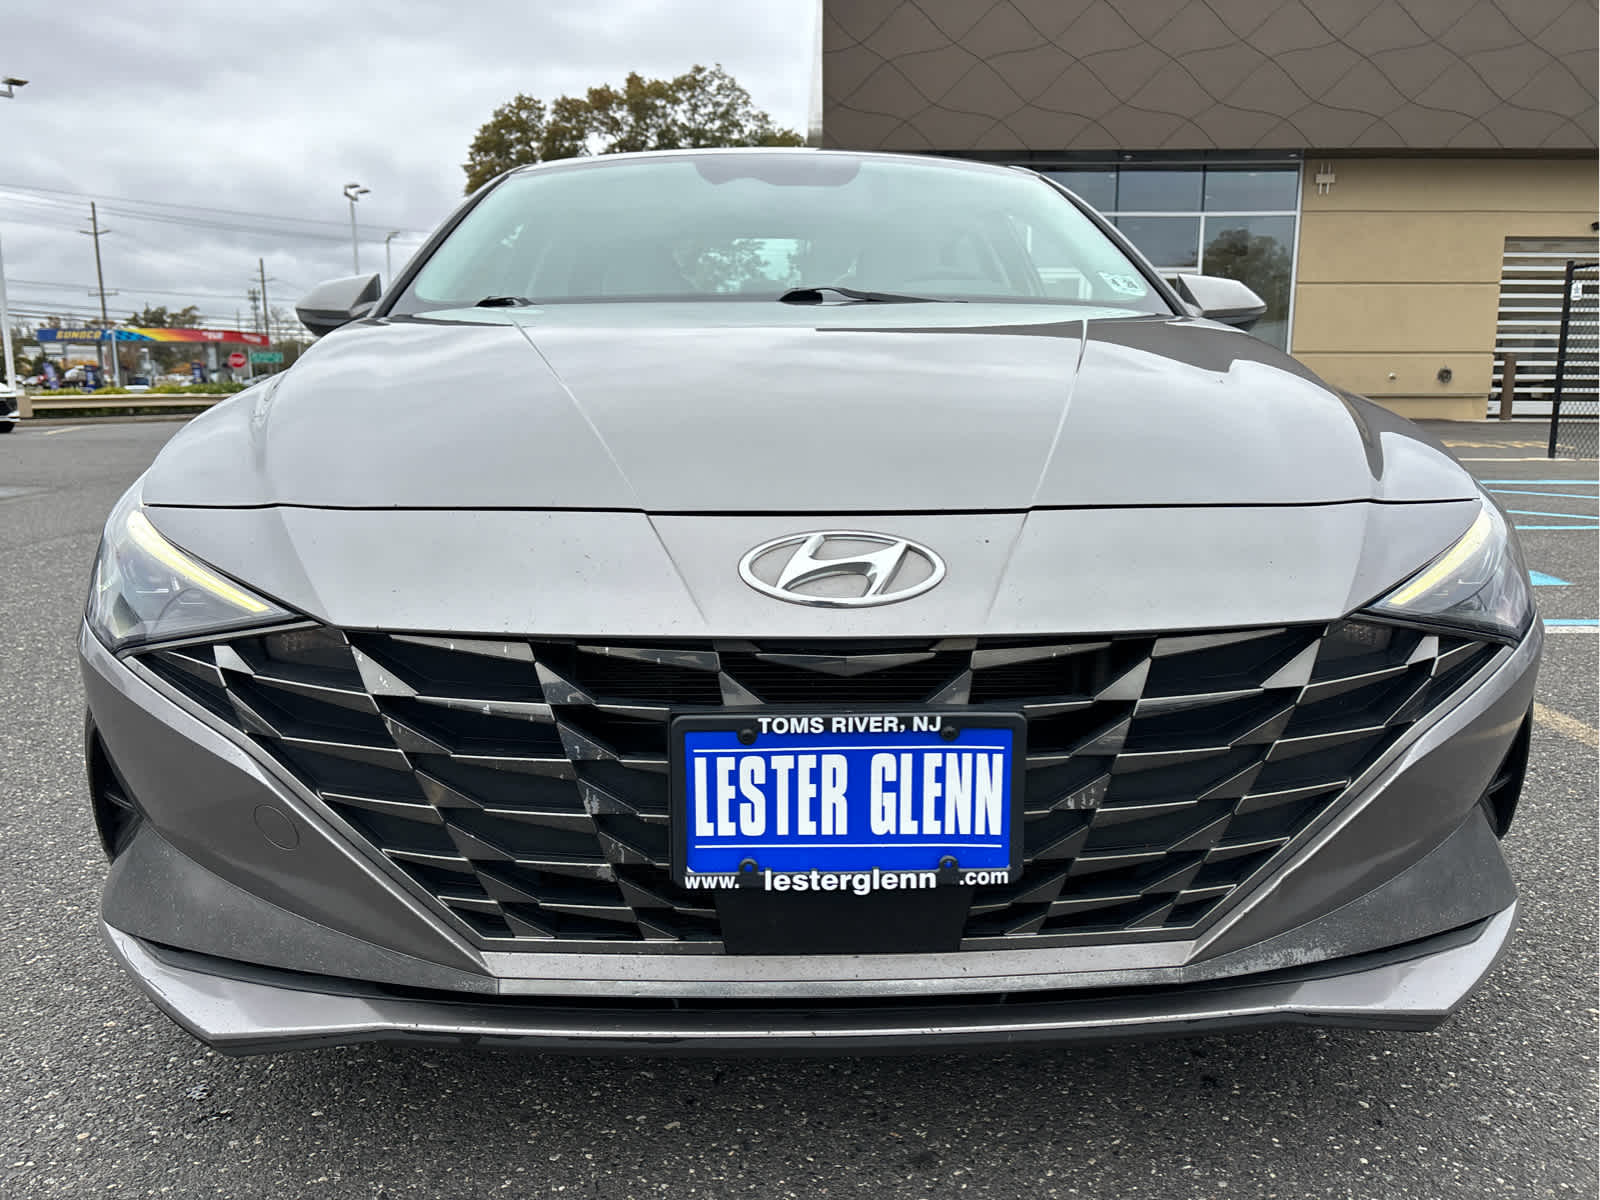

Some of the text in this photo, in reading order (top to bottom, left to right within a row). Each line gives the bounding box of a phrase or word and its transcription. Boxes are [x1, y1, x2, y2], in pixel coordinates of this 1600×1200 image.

[757, 715, 942, 734] TOMS RIVER, NJ
[694, 752, 1004, 837] LESTER GLENN
[684, 867, 1009, 896] www. lesterglenn .com
